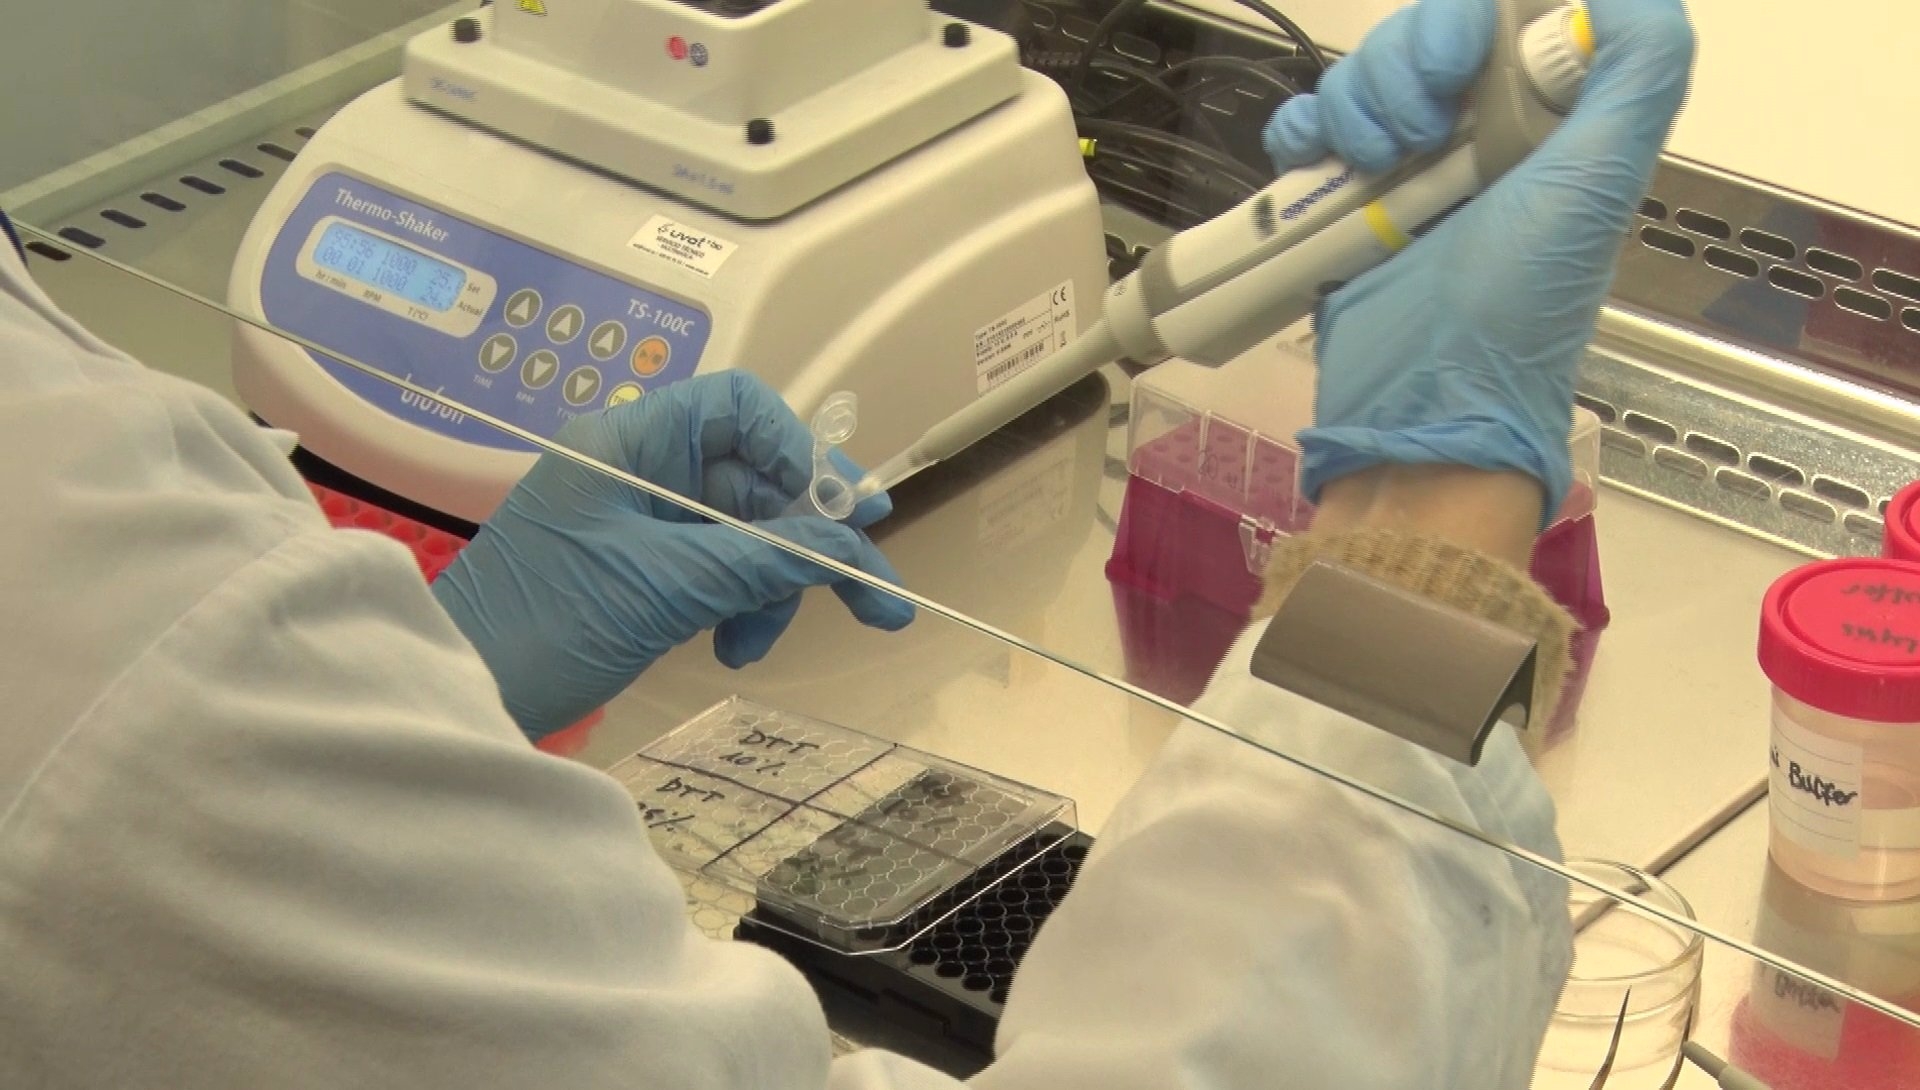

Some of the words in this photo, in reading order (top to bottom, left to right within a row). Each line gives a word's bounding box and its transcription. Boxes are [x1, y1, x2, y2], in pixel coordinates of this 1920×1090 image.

[334, 187, 449, 243] Thermo-Shaker
[626, 298, 695, 337] TS-100C
[738, 729, 820, 754] DTT
[655, 776, 726, 802] DTT
